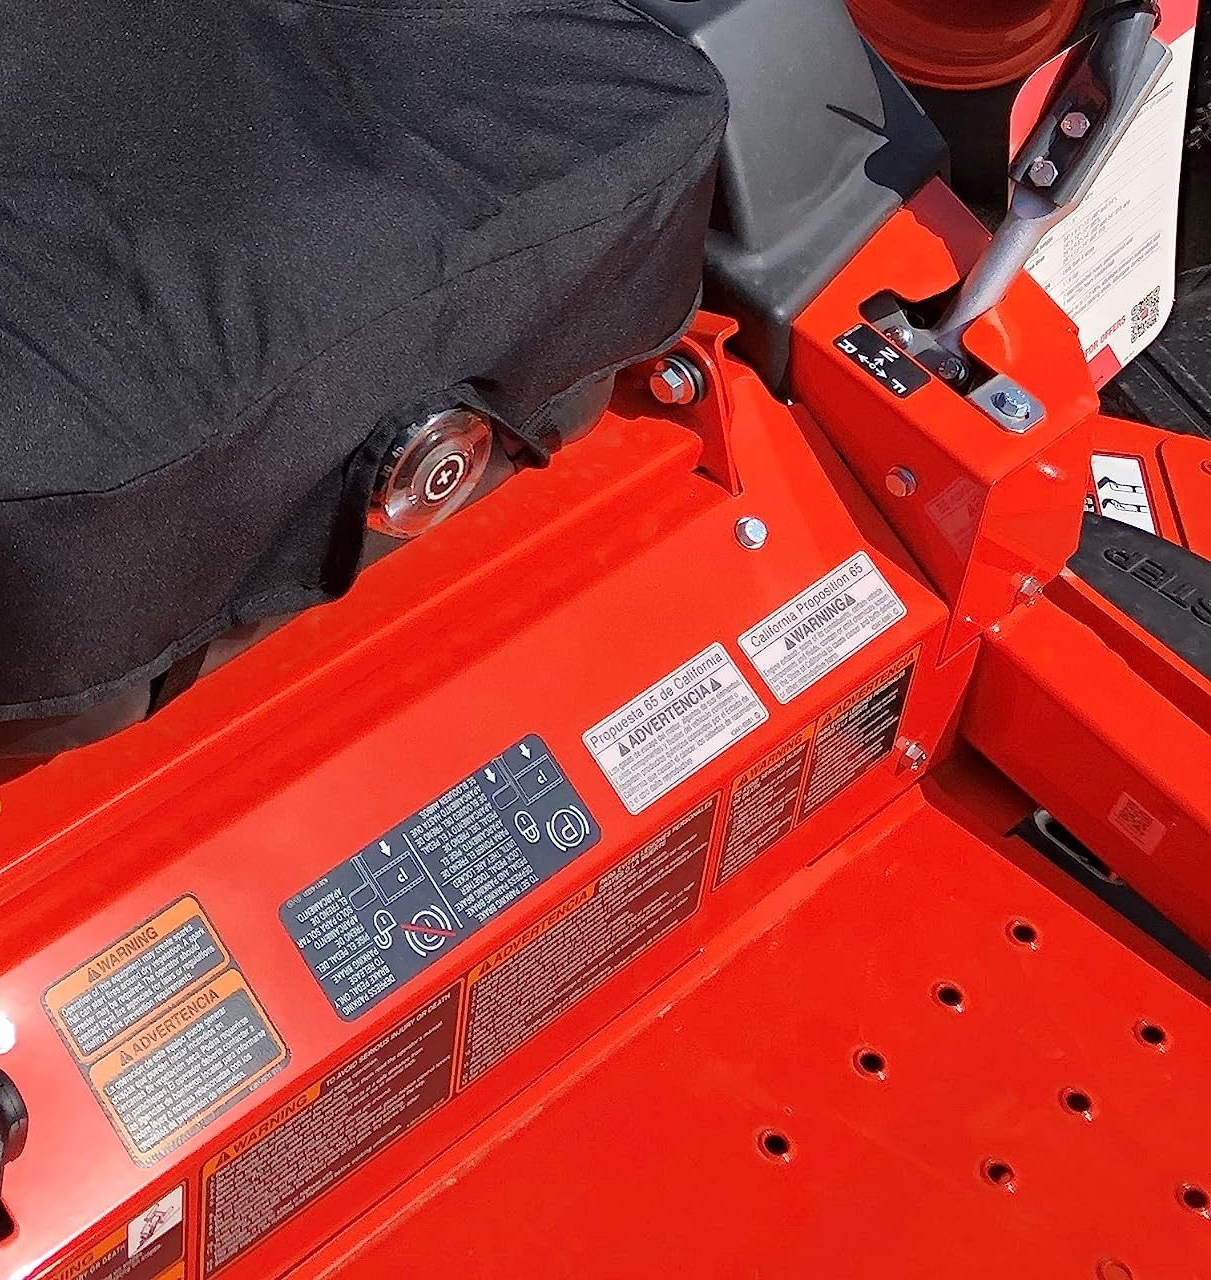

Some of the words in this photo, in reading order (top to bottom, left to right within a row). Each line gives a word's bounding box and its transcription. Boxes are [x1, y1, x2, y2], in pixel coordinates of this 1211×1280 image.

[1100, 314, 1125, 346] OFFERS
[837, 339, 858, 354] R
[879, 346, 900, 362] N
[891, 378, 908, 394] F
[748, 609, 798, 648] California
[795, 571, 851, 617] Proposition
[847, 561, 863, 578] 65
[788, 596, 847, 644] WARNING
[833, 652, 913, 716] ADVERTENCIA
[589, 704, 646, 751] Propuesta
[642, 694, 660, 712] 65
[657, 684, 674, 701] de
[672, 650, 723, 691] California
[625, 682, 711, 749] ADVERTENCIA
[748, 733, 802, 779] WARNING
[466, 775, 476, 786] SE
[438, 781, 469, 806] BLOQUEEN
[476, 792, 487, 804] DE
[451, 798, 479, 821] BLOQUEO
[478, 810, 498, 827] PEDAL
[421, 812, 441, 829] HASTA
[440, 815, 454, 828] DEL
[467, 821, 481, 835] DEL
[408, 824, 423, 838] QUE
[422, 823, 443, 841] FRENO
[438, 832, 448, 843] EL
[445, 829, 453, 838] Y
[449, 829, 470, 847] FRENO
[491, 827, 509, 843] PARA
[414, 836, 425, 847] DE
[420, 837, 440, 856] PEDAL
[441, 842, 452, 853] DE
[474, 837, 494, 855] PONER
[498, 838, 516, 854] UNTIL
[439, 856, 450, 867] EL
[447, 847, 462, 862] PISE
[466, 850, 476, 861] EL
[485, 849, 501, 864] THEY
[504, 846, 522, 863] LOCK
[447, 855, 468, 874] FRENO
[472, 859, 486, 873] ARE
[487, 857, 507, 875] PEDAL
[508, 855, 527, 873] PEDAL
[439, 868, 450, 880] DE
[459, 869, 490, 895] TOGETHER
[496, 868, 510, 882] AND
[506, 864, 533, 887] DEPRESS
[527, 872, 539, 884] TO
[472, 876, 499, 899] PARKING
[483, 881, 509, 904] PARKING
[517, 878, 530, 891] SET
[337, 896, 348, 907] EL
[453, 893, 475, 912] BRAKE
[494, 886, 520, 908] PARKING
[318, 901, 340, 920] FRENO
[464, 898, 485, 917] BRAKE
[309, 914, 320, 927] DE
[318, 915, 338, 933] PARA
[494, 888, 588, 965] ADVERTENCIA
[295, 927, 321, 949] SOLTAR
[342, 922, 364, 942] FRENO
[354, 931, 370, 947] PISE
[96, 925, 158, 974] WARNING
[333, 936, 345, 948] DE
[346, 941, 357, 952] EL
[327, 946, 349, 966] PEDAL
[351, 946, 379, 970] PARKING
[372, 955, 384, 967] TO
[315, 960, 330, 975] DEL
[347, 961, 375, 985] RELEASE
[367, 964, 390, 984] BRAKE
[348, 978, 370, 997] PEDAL
[366, 973, 395, 998] DEPRESS
[332, 991, 351, 1008] ONLY
[340, 991, 369, 1016] PARKING
[130, 987, 219, 1055] ADVERTENCIA
[325, 1075, 335, 1088] TO
[336, 1058, 357, 1080] AVOID
[359, 1035, 390, 1064] SERIOUS
[390, 1017, 414, 1041] INJURY
[416, 1009, 426, 1022] OR
[428, 991, 451, 1014] DEATH
[234, 1092, 306, 1154] WARNING
